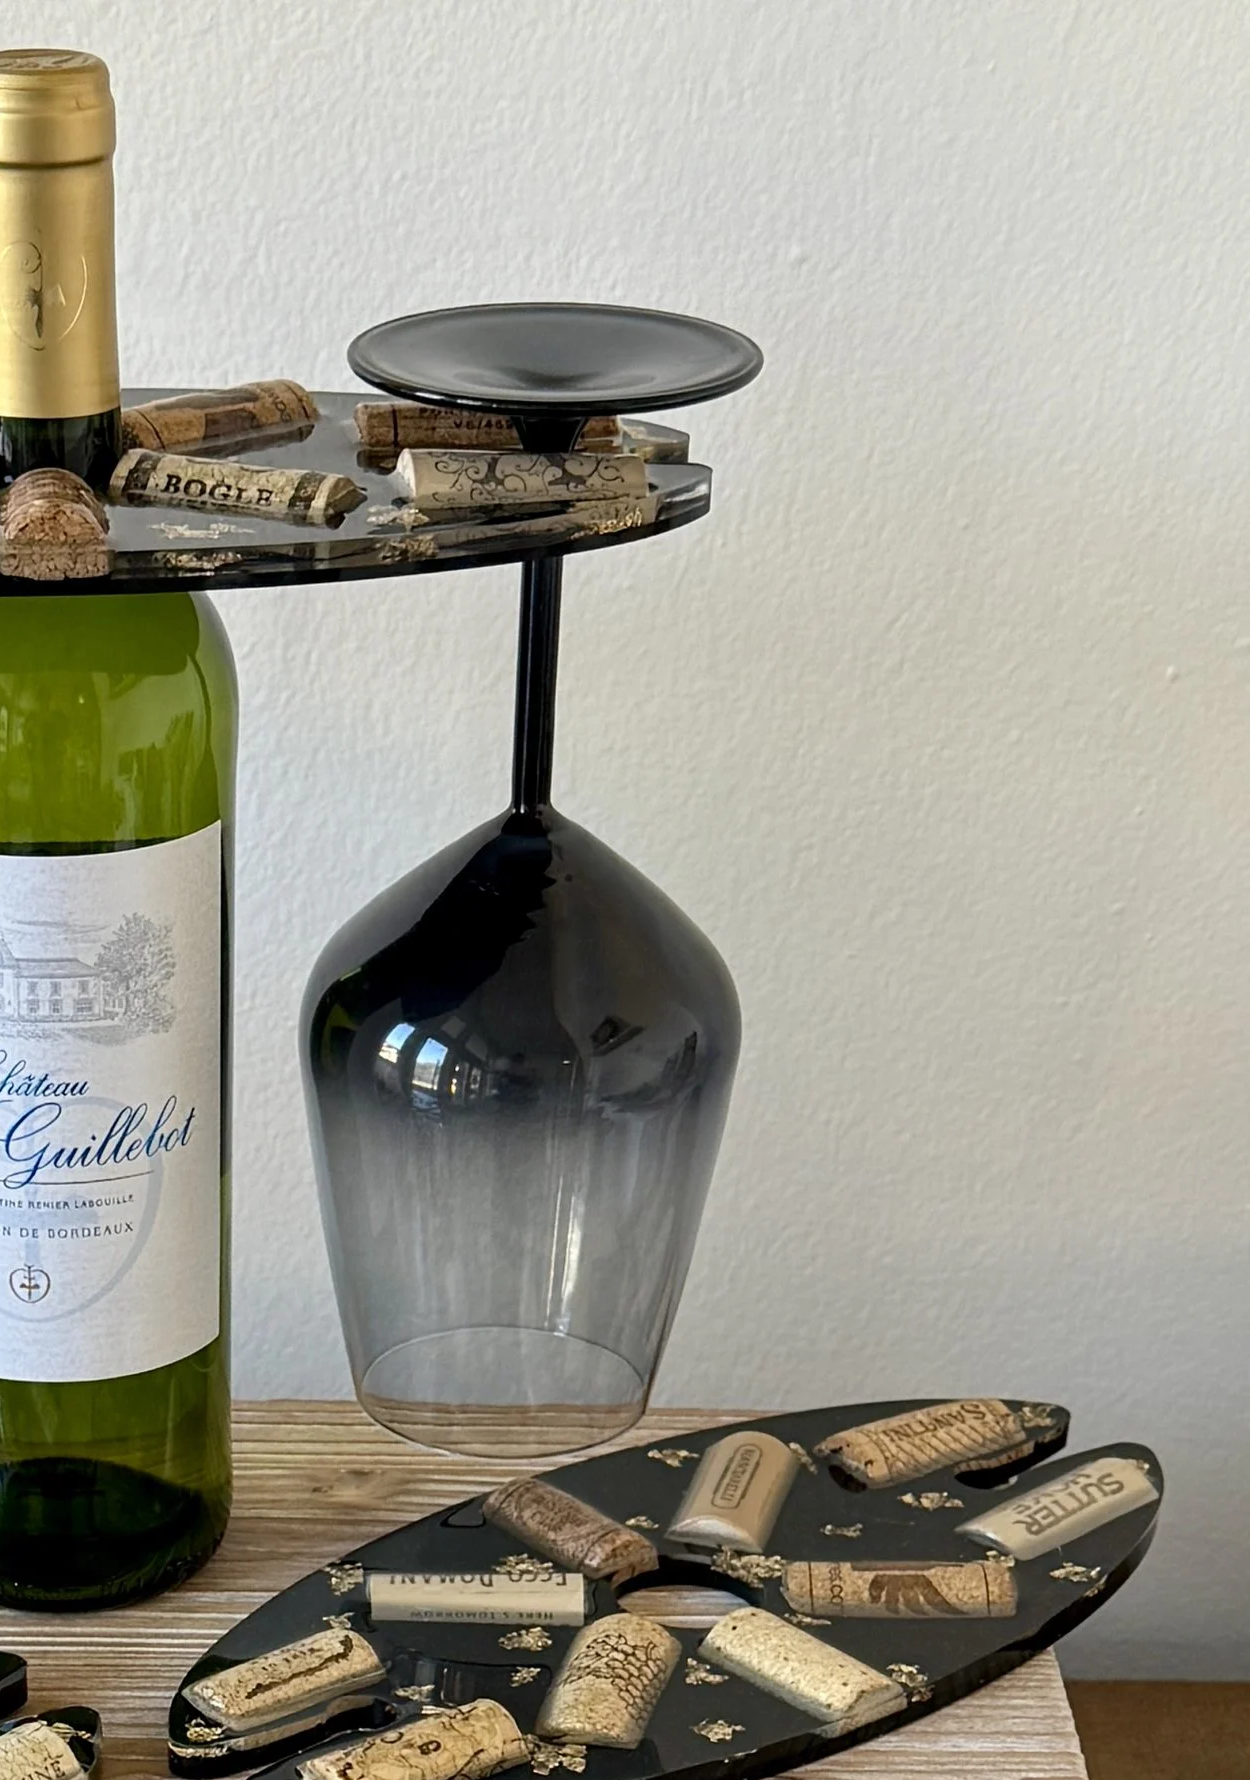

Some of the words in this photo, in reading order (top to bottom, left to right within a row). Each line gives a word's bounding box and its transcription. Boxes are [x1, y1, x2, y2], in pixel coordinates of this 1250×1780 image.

[160, 474, 274, 506] BOGLE
[20, 1227, 39, 1238] DE
[48, 1222, 134, 1238] BORDEAUX
[1012, 1472, 1124, 1536] SUTTER
